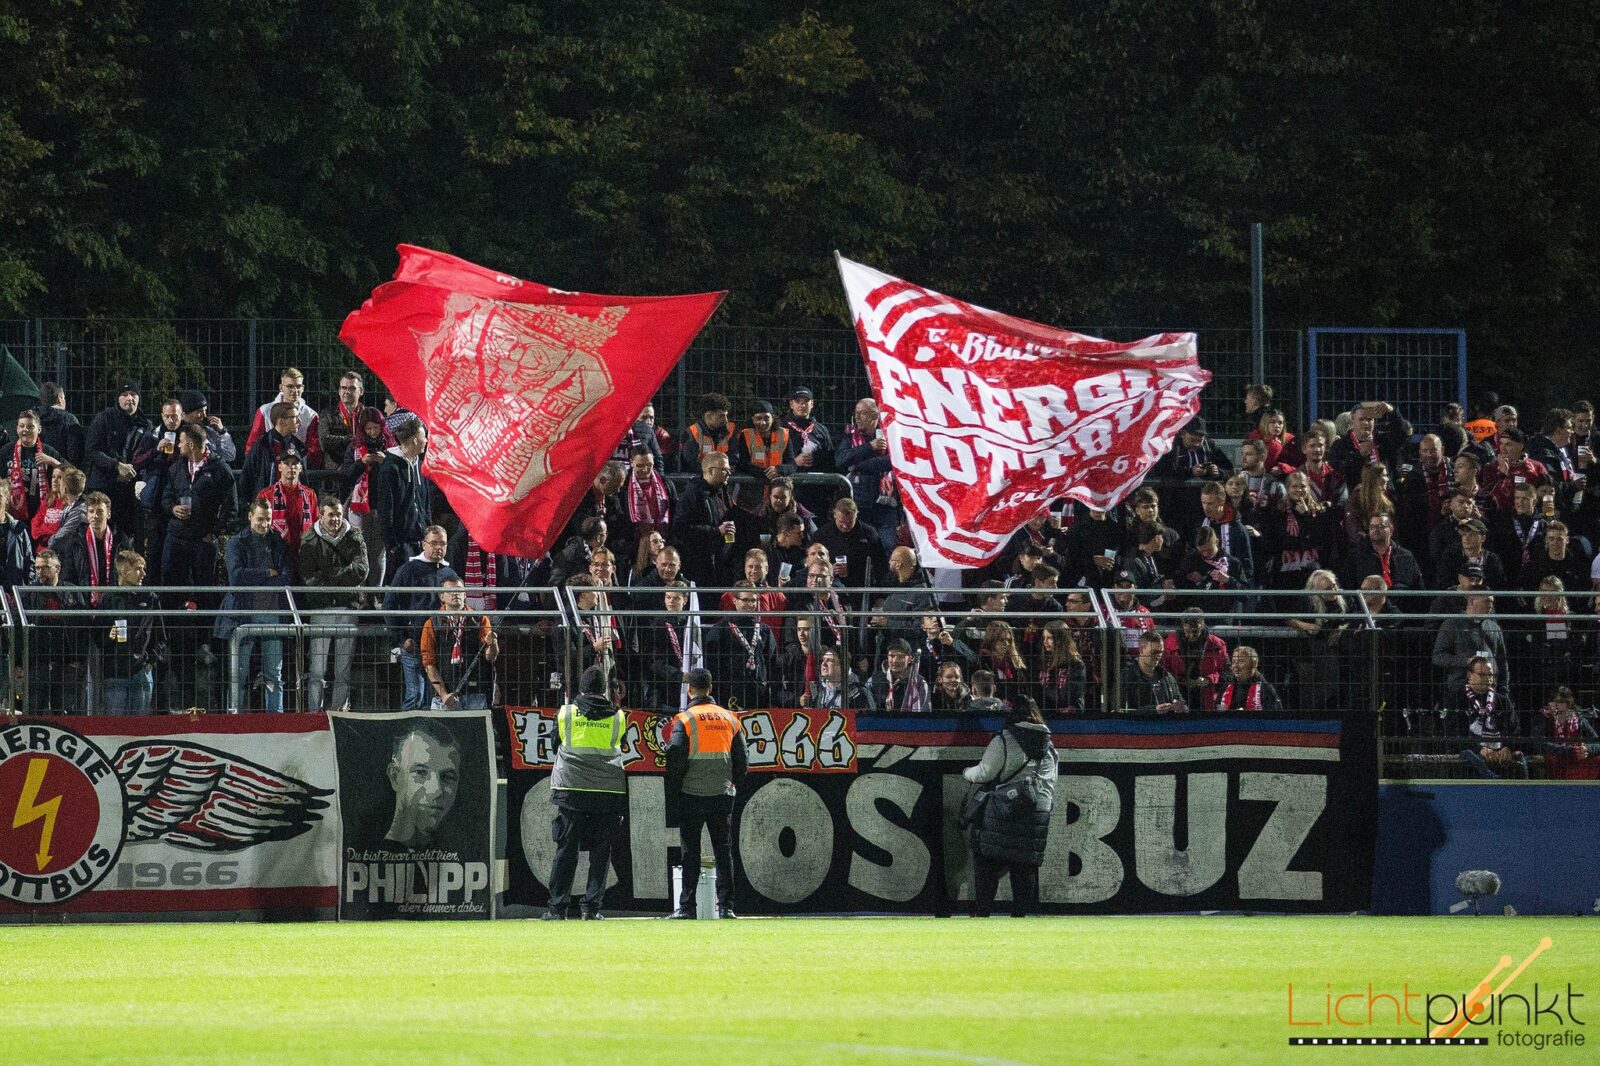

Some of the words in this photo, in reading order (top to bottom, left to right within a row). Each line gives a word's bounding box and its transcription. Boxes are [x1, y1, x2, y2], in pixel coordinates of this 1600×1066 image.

[575, 721, 611, 730] SUPERVISOR
[743, 711, 856, 770] 966
[0, 726, 111, 785] ERGIE
[117, 861, 239, 889] 1966
[346, 861, 488, 904] PHILIPP
[422, 902, 456, 913] immer
